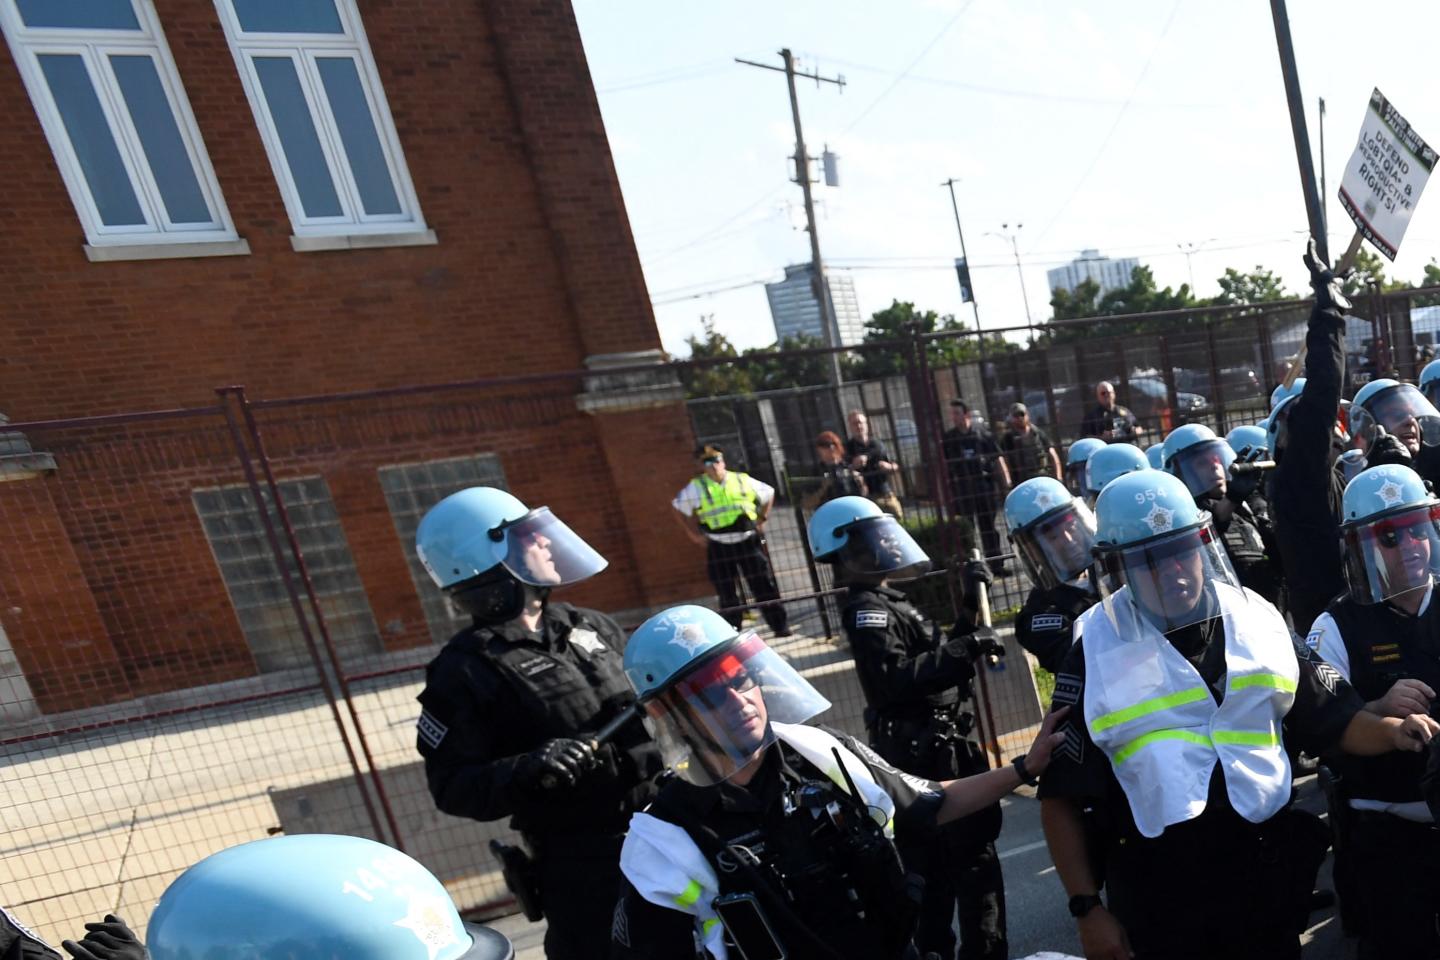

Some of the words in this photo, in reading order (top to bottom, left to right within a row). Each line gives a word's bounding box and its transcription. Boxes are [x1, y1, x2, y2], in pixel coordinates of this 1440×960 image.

[1359, 142, 1412, 210] REPRODUCTIVE
[1363, 132, 1403, 184] LGBTQIA+
[1404, 184, 1412, 196] &
[1375, 130, 1410, 175] DEFEND
[1358, 163, 1396, 214] RIGHTS!
[1135, 487, 1168, 505] 954
